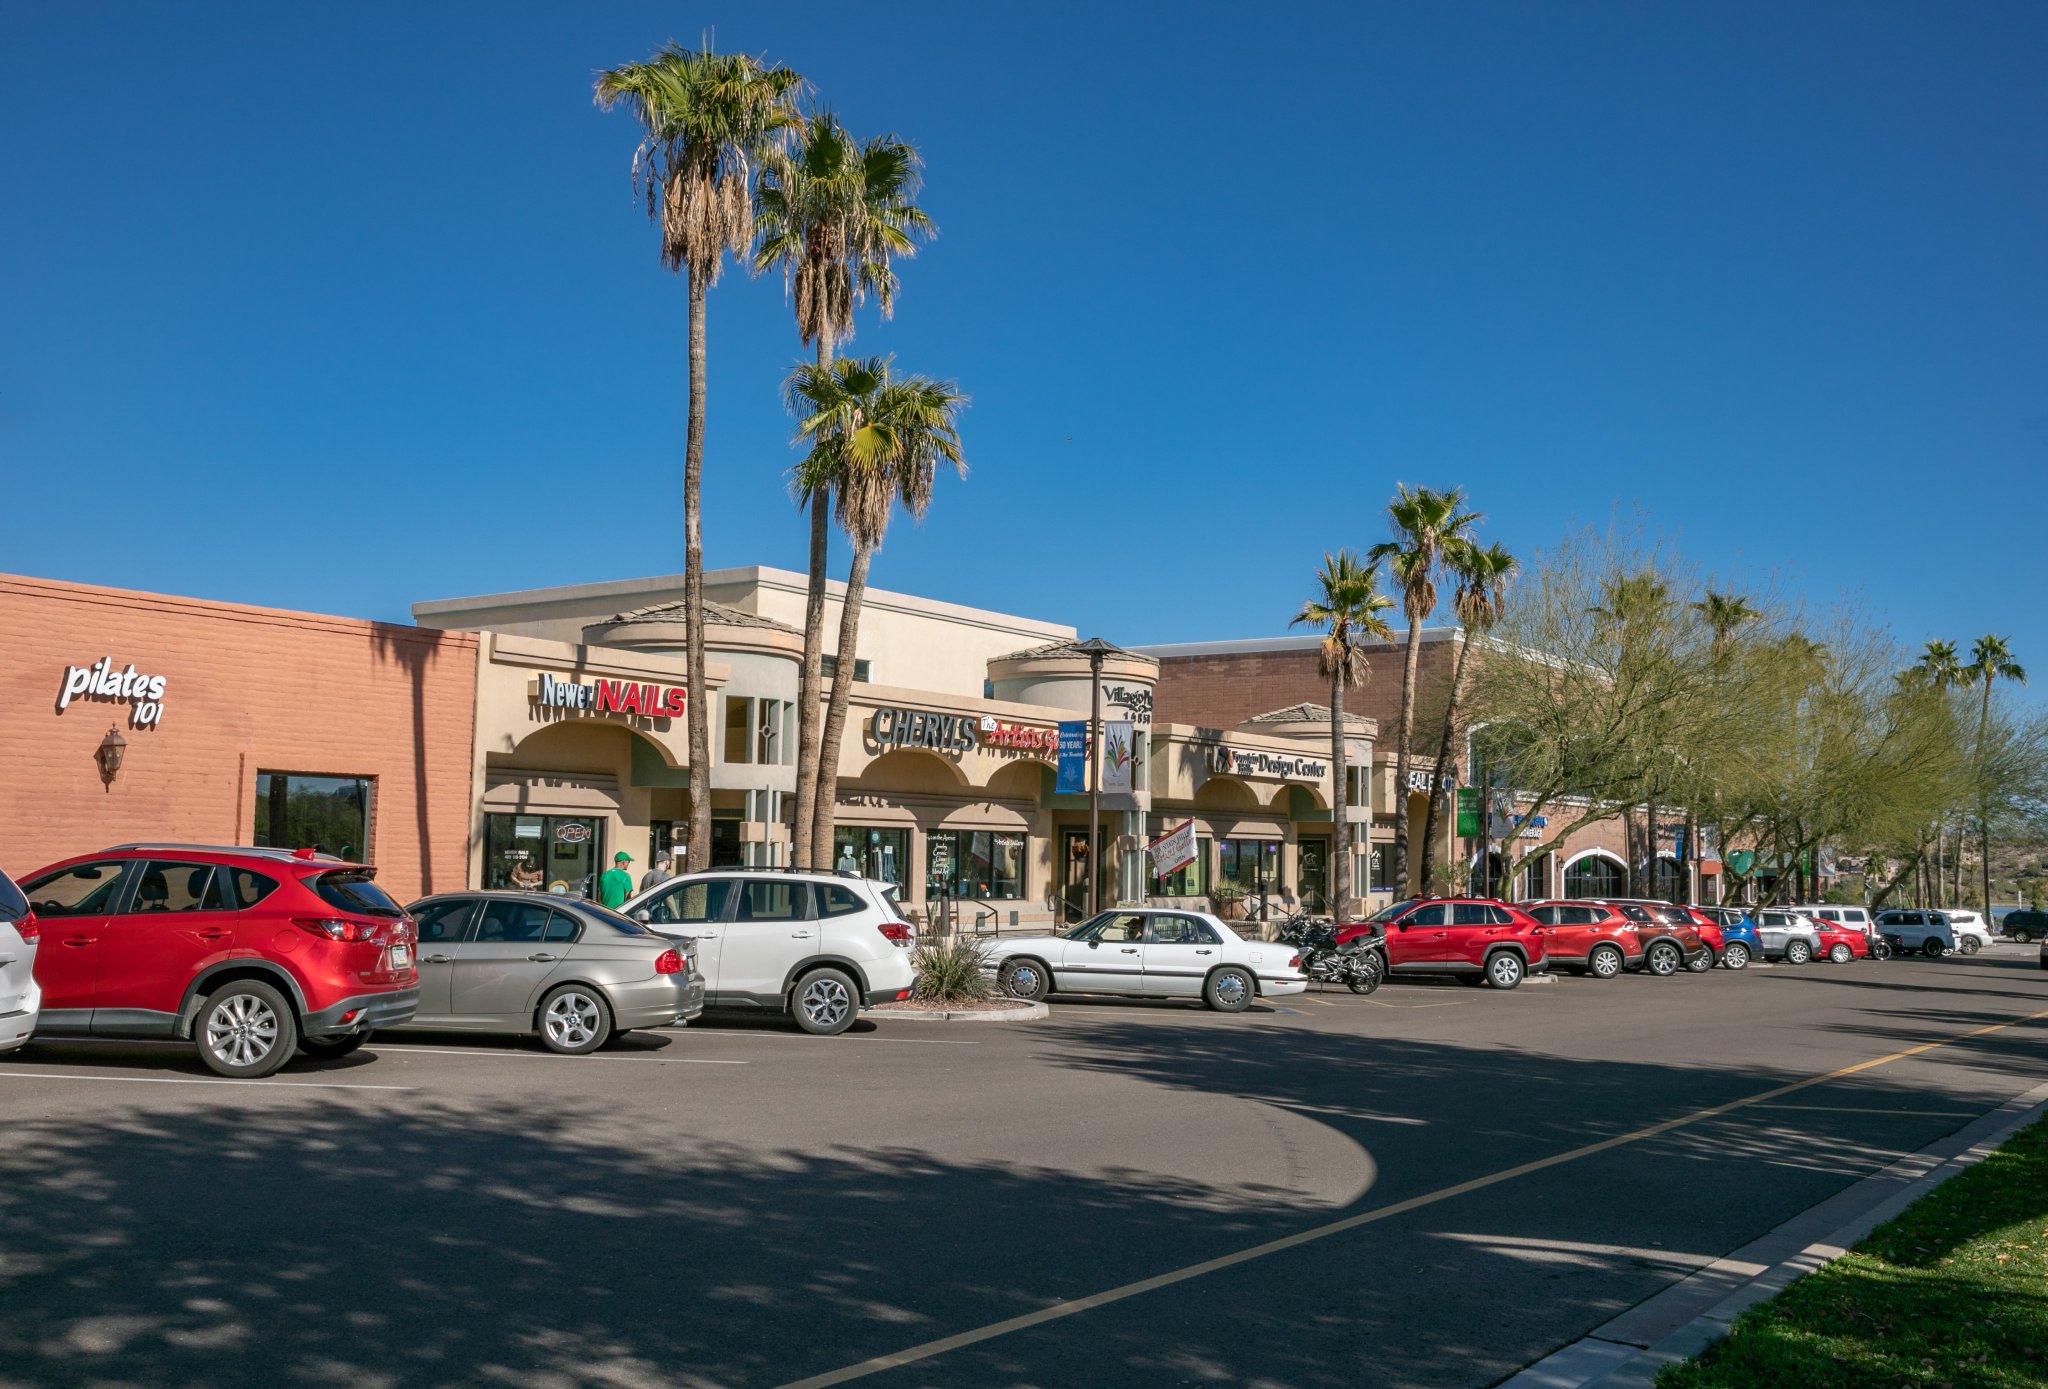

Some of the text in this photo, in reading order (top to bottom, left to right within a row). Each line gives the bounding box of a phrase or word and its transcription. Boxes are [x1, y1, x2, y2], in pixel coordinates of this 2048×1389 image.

[60, 656, 167, 708] pilates
[541, 672, 687, 718] Newer NAILS
[134, 702, 164, 725] 101
[873, 708, 976, 752] CHERYLS
[982, 718, 995, 730] The
[990, 720, 1043, 749] Artists
[1059, 740, 1083, 749] 50 YEARS
[1259, 754, 1294, 778] Design
[1295, 758, 1327, 777] Center
[1408, 771, 1427, 790] EAL
[556, 826, 591, 839] OPEN
